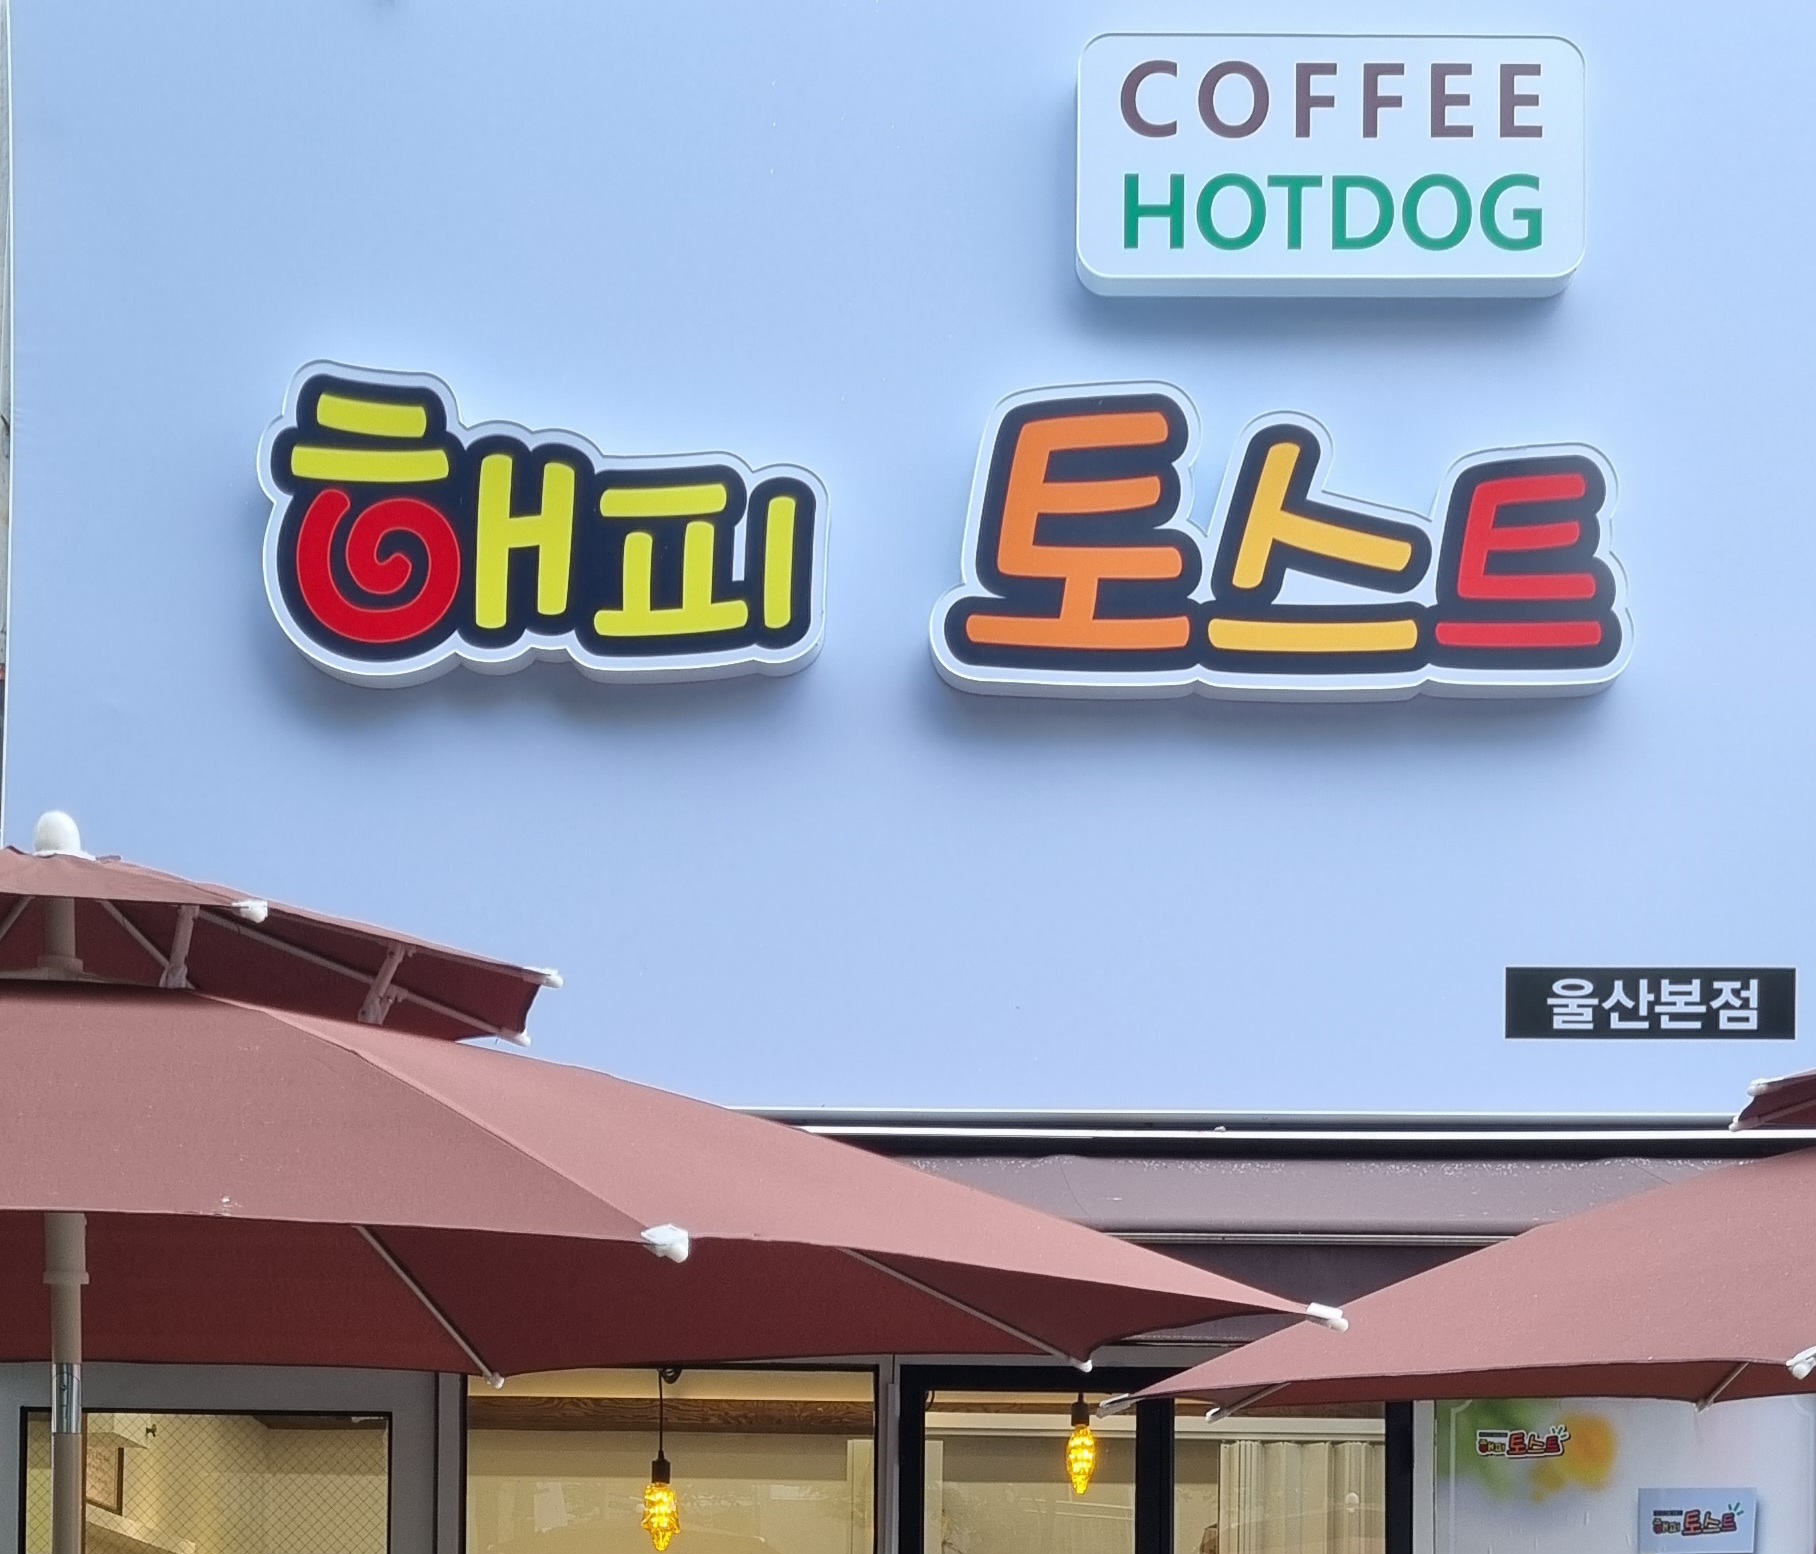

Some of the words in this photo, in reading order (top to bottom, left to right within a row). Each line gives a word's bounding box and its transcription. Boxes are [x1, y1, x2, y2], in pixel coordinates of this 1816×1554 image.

[1119, 59, 1544, 139] COFFEE
[1122, 172, 1544, 252] HOTDOG
[284, 386, 802, 648] 해피
[958, 404, 1608, 655] 토스트
[1546, 977, 1759, 1031] 울산본점
[1507, 1432, 1561, 1456] 토스트
[1681, 1509, 1737, 1537] 토스트
